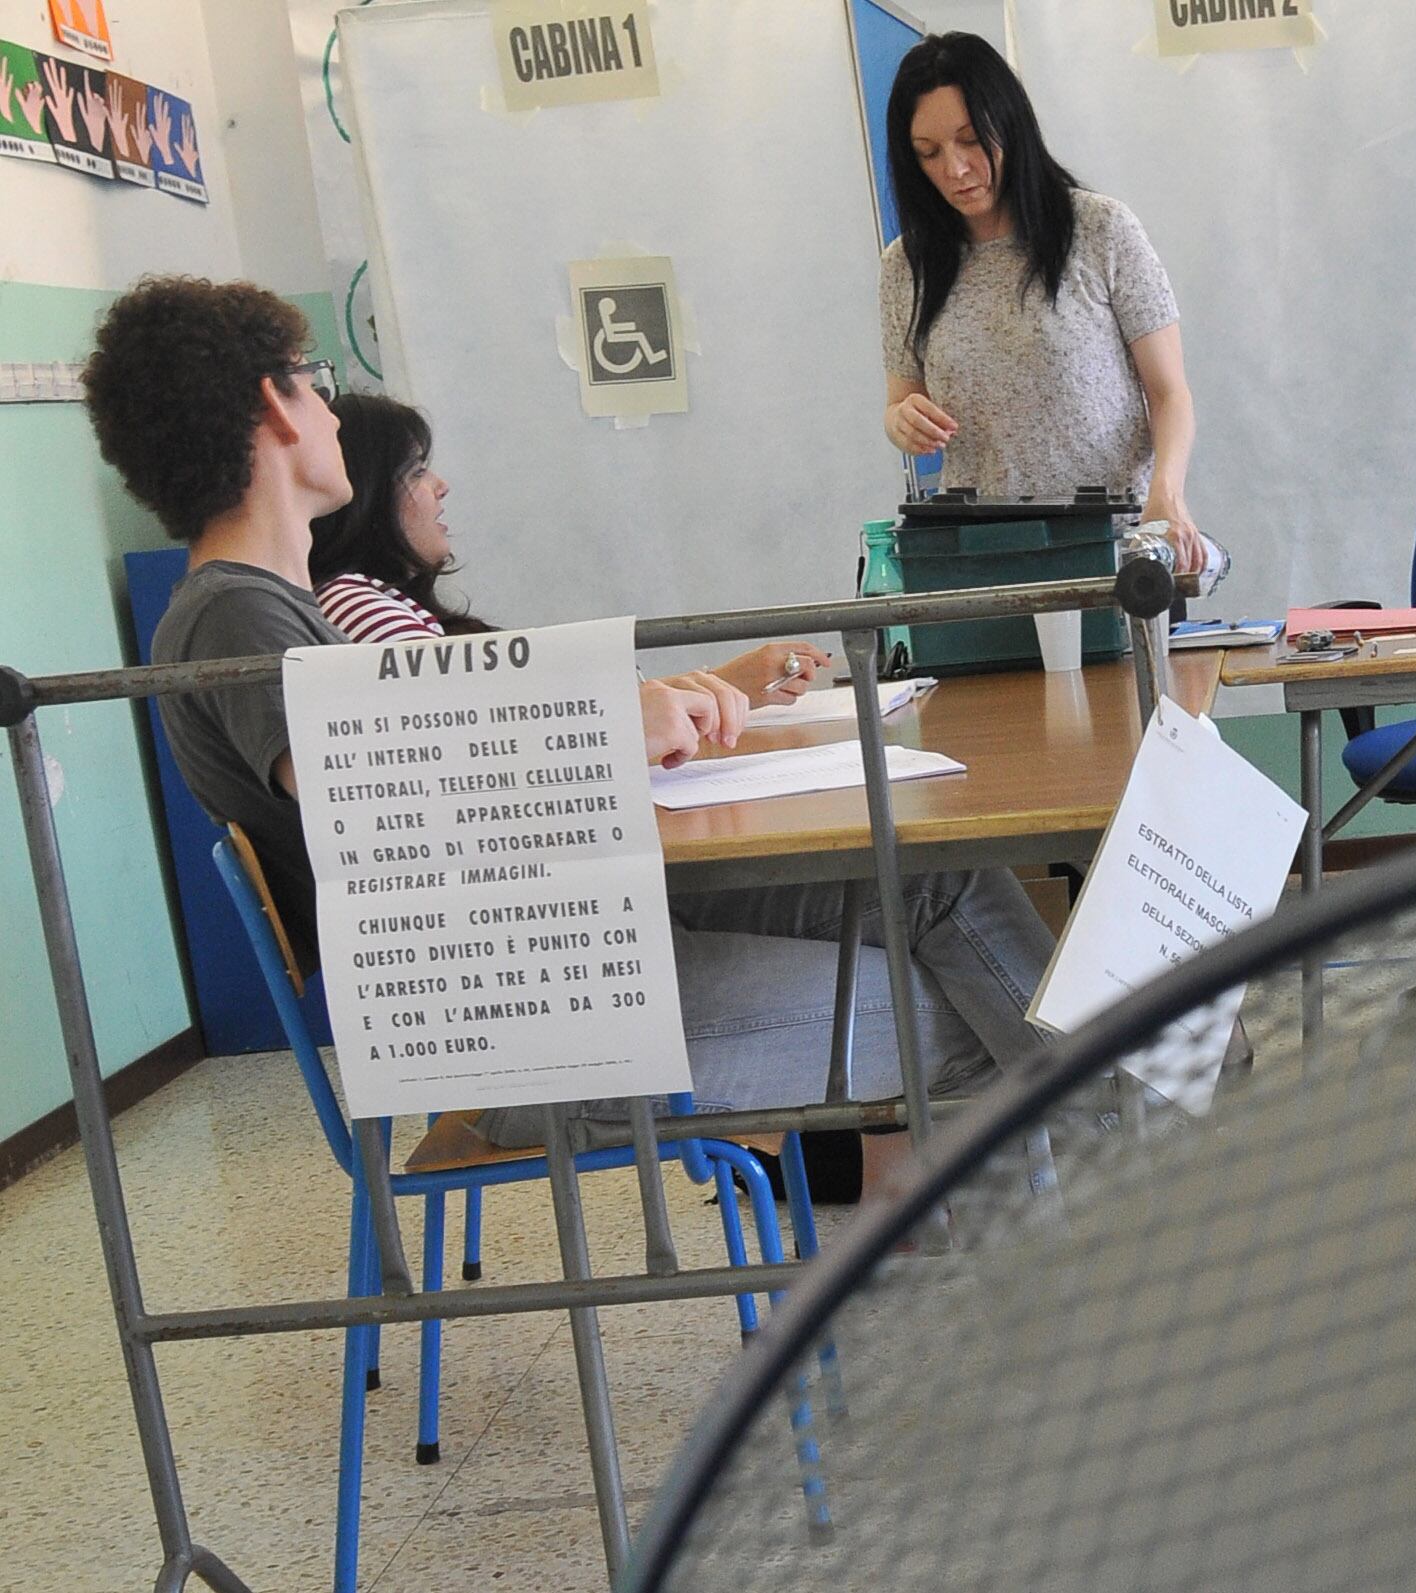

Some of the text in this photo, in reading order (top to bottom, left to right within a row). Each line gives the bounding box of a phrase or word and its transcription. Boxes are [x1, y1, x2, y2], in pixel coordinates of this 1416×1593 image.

[509, 13, 642, 83] CABINA 1
[378, 636, 530, 680] AVVISO
[328, 699, 605, 737] NON SI POSSONO INTRODURRE,
[470, 739, 518, 758] DELLE
[545, 732, 608, 751] CABINE
[329, 764, 613, 802] ELETTORALI, TELEFONI CELLULARI
[334, 795, 617, 835] O ALTRE APPARECCHIATURE
[340, 827, 623, 866] IN GRADO DI FOTOGRAFARE O
[348, 863, 551, 895] REGISTRARE IMMAGINI.
[1127, 854, 1196, 911] ELETTORALE
[1138, 823, 1253, 920] ESTRATTO DELLA LISTA
[359, 897, 633, 935] CHIUNQUE CONTRAVVIENE A
[1142, 902, 1173, 932] DELLA
[353, 929, 637, 968] QUESTO DIVIETO È PUNITO CON
[1158, 944, 1168, 959] N.
[358, 959, 642, 999] L'ARRESTO DA TRE A SEI MESI
[364, 991, 646, 1030] E CON L'AMMENDA DA 300
[370, 1036, 495, 1061] A 1.000 EURO.
